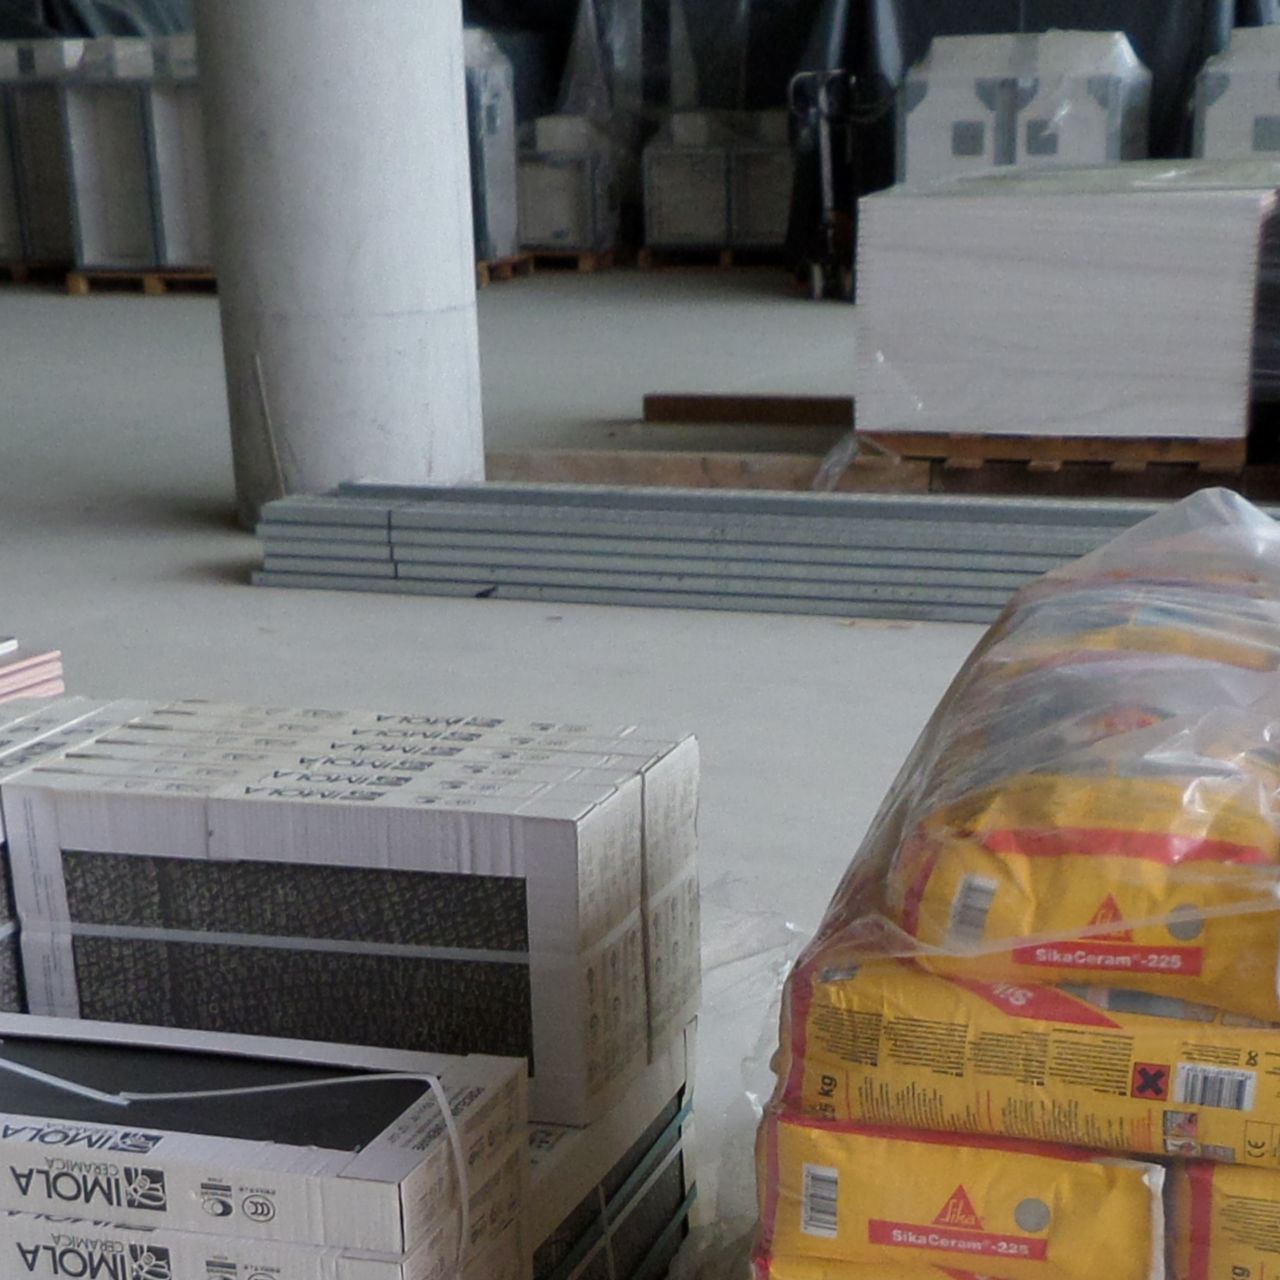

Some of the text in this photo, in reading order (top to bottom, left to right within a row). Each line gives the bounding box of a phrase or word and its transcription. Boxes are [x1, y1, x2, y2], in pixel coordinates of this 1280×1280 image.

[818, 1074, 838, 1098] kg
[2, 1124, 113, 1149] IMOLA
[44, 1157, 120, 1177] CERAMICA
[9, 1165, 122, 1208] IMOLA
[940, 1200, 977, 1227] Sika
[51, 1233, 124, 1254] CERAMICA
